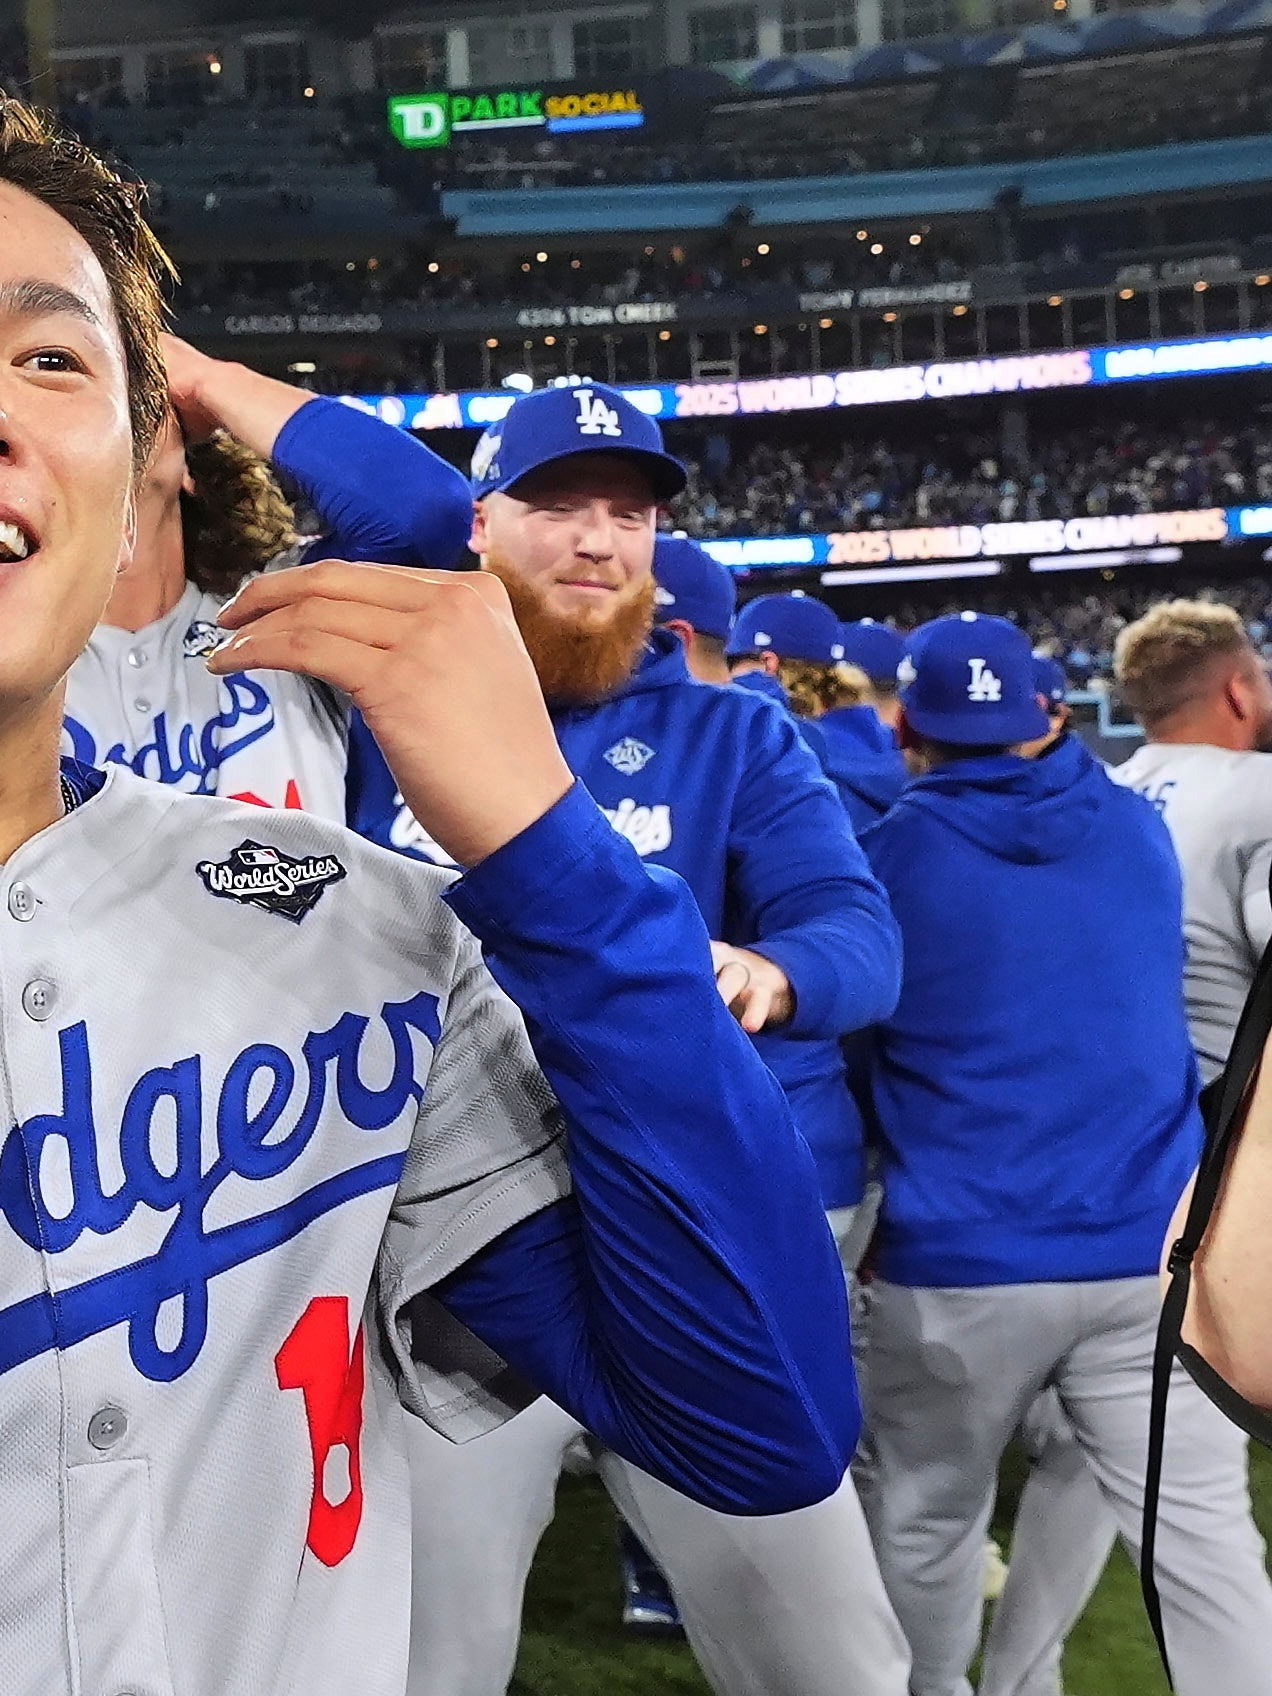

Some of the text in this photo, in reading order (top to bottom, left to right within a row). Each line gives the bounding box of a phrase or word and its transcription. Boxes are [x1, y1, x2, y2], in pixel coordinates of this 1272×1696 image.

[393, 103, 445, 139] TD
[451, 90, 642, 121] PARK SOCIAL
[572, 389, 622, 437] LA
[675, 382, 738, 417] 2025
[738, 374, 836, 413] WORLD
[827, 530, 890, 564] 2025
[890, 524, 981, 560] WORLD
[967, 658, 1002, 702] LA
[200, 857, 340, 896] World Series
